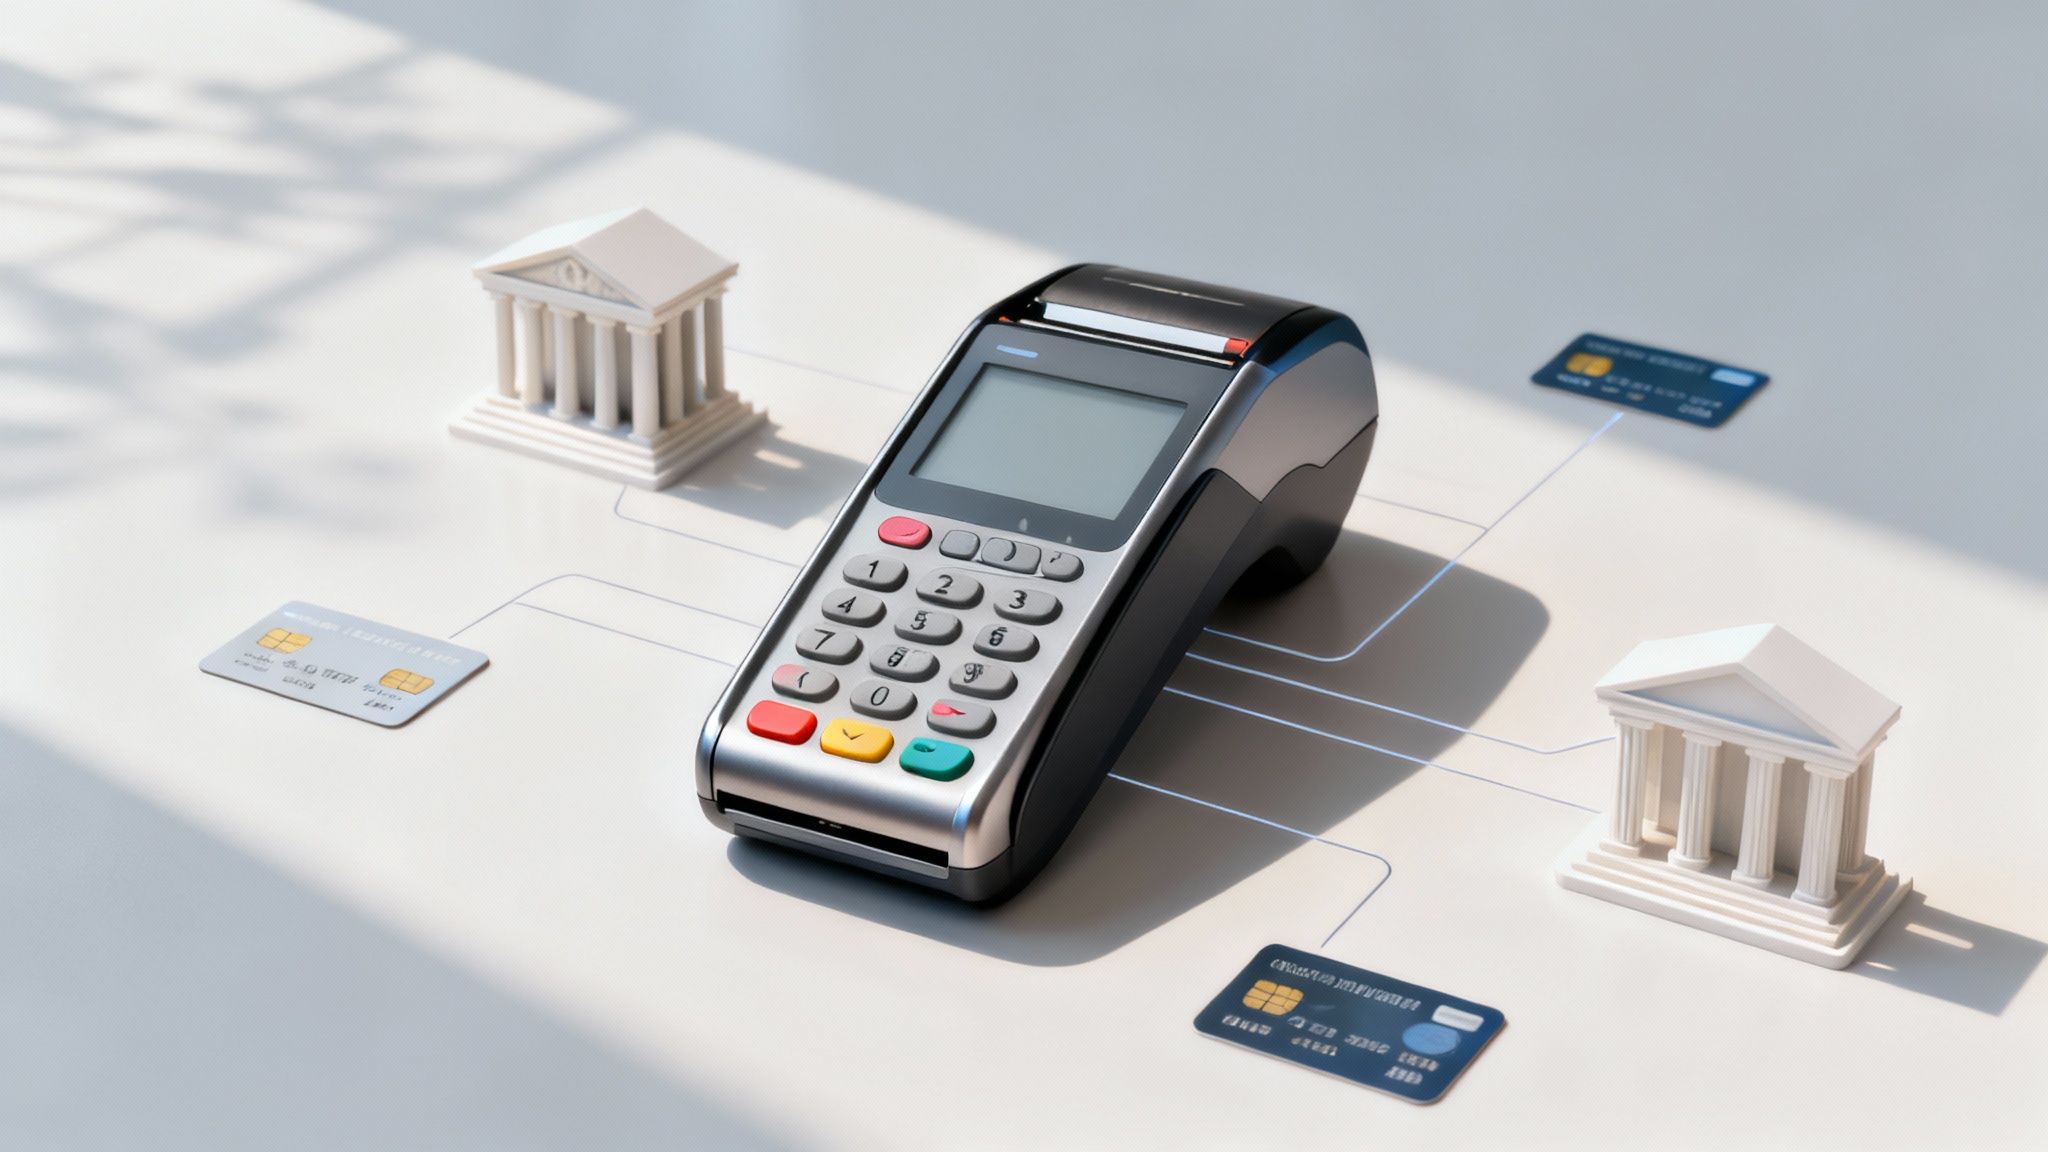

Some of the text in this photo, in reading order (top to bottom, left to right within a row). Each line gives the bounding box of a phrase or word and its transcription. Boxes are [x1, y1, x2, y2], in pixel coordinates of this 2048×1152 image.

[868, 559, 880, 579] 1
[934, 574, 953, 595] 2
[837, 596, 857, 614] 4
[1008, 589, 1028, 610] 3
[813, 628, 836, 651] 7
[870, 686, 890, 706] 0
